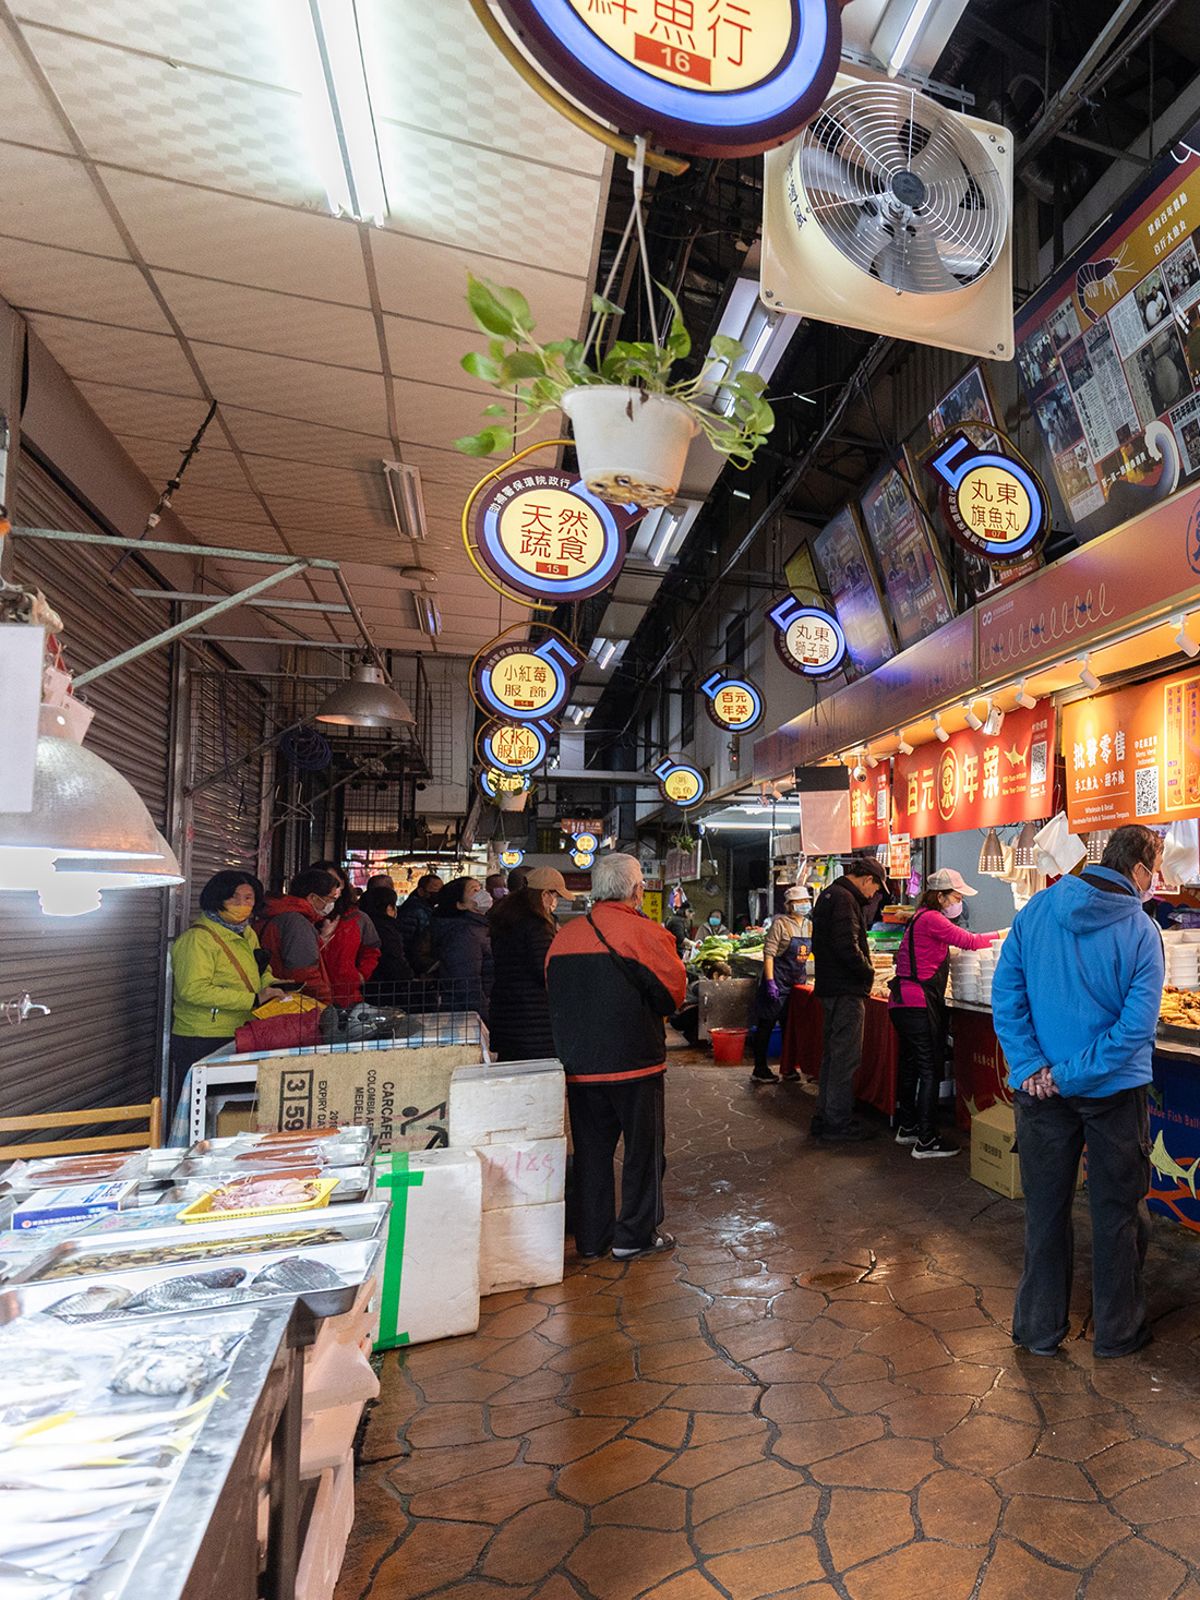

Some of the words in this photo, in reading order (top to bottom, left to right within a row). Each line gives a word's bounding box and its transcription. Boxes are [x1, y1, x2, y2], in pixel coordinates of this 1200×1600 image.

[660, 47, 691, 73] 16
[971, 479, 1018, 505] 丸東
[521, 503, 588, 538] 天然
[971, 504, 1020, 531] 旗魚丸
[991, 530, 1001, 538] 07
[520, 529, 587, 564] 蔬食
[546, 564, 560, 574] 15
[796, 624, 830, 643] 丸東
[504, 664, 546, 683] 小紅莓
[503, 684, 547, 698] 服飾
[722, 692, 747, 702] 百元
[722, 705, 748, 715] 年菜
[497, 745, 534, 759] 服飾
[1073, 731, 1126, 771] 批發零售
[907, 768, 934, 816] 百元
[963, 744, 999, 802] 年菜
[286, 1079, 306, 1092] 3
[318, 1080, 327, 1113] EXPIRY
[366, 1069, 377, 1115] COLOMBIA
[380, 1081, 395, 1142] CARCAFE
[1167, 1110, 1182, 1124] Fish
